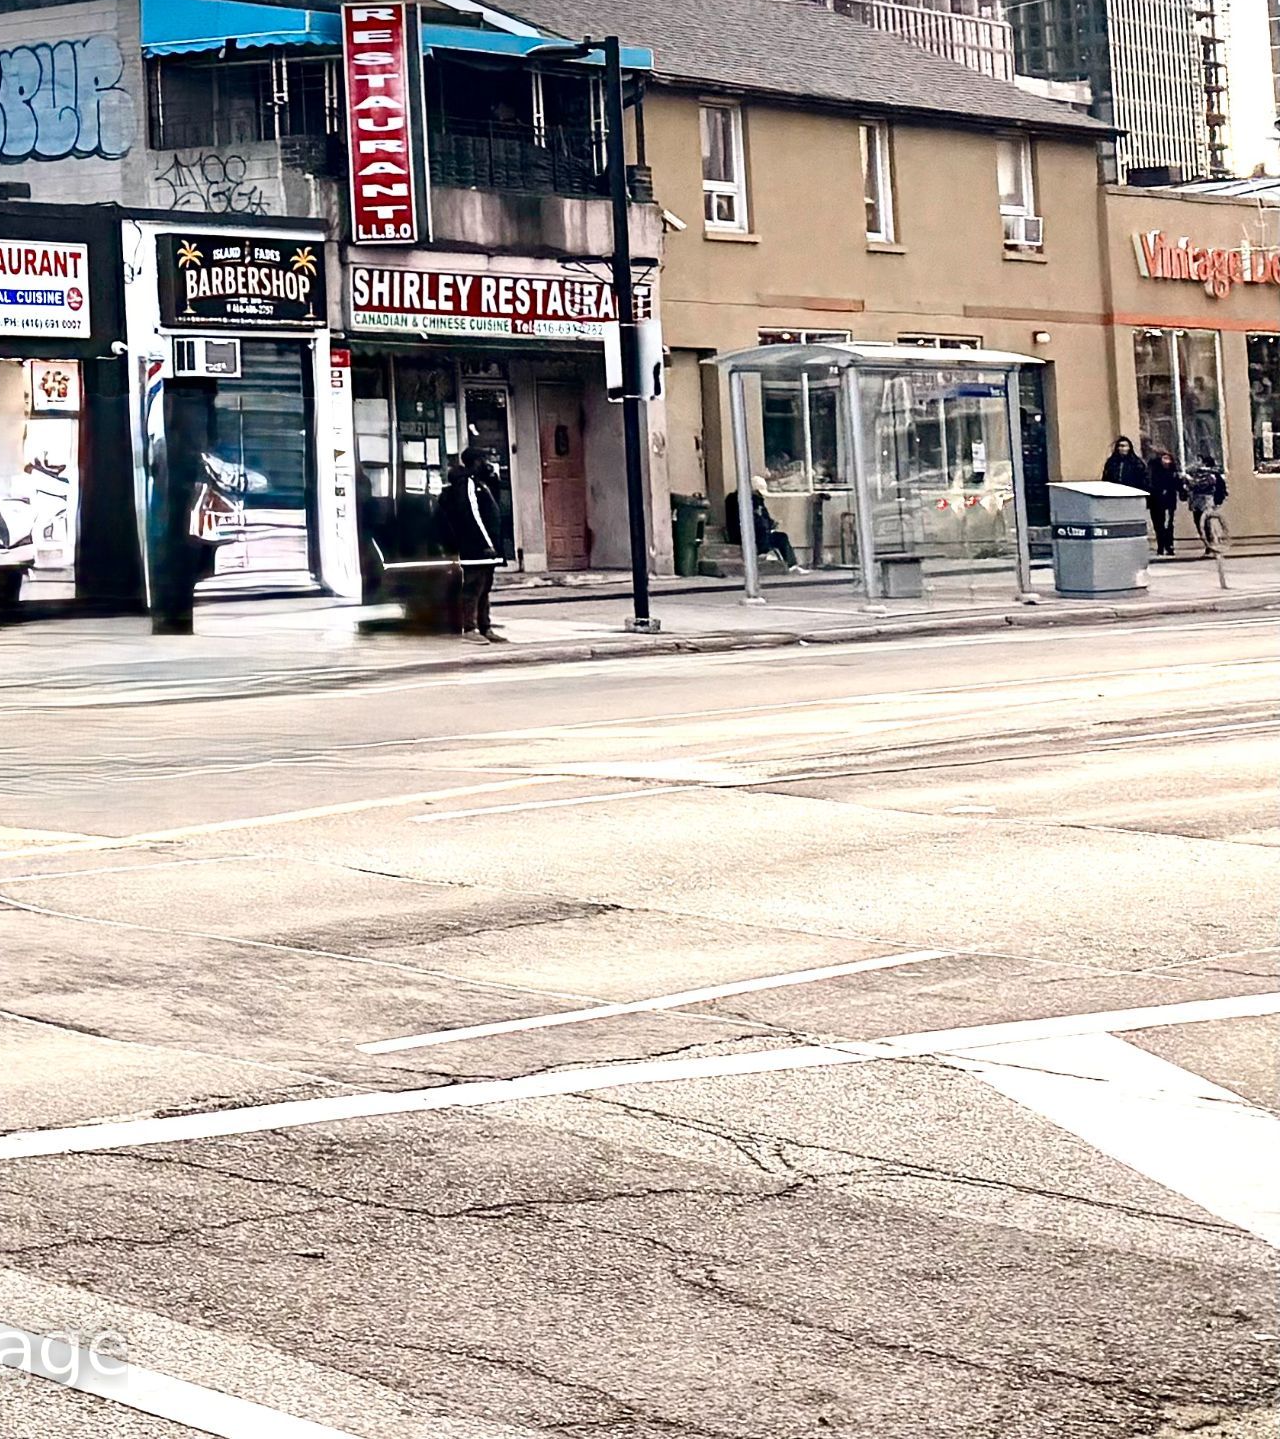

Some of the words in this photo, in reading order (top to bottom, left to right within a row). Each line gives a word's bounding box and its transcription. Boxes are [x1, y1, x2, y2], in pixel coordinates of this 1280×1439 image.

[351, 8, 409, 219] RESTAURANT
[358, 223, 411, 240] L.L.B.O
[1131, 229, 1244, 299] Vintage
[16, 290, 62, 304] CUISINE
[185, 266, 311, 305] BARBERSHOP
[353, 268, 474, 312] SHIRLEY
[481, 277, 649, 321] RESTAURAT
[353, 314, 408, 327] CANADIAN
[412, 317, 419, 328] &
[422, 317, 466, 330] CHINESE
[469, 319, 510, 333] CUISINE
